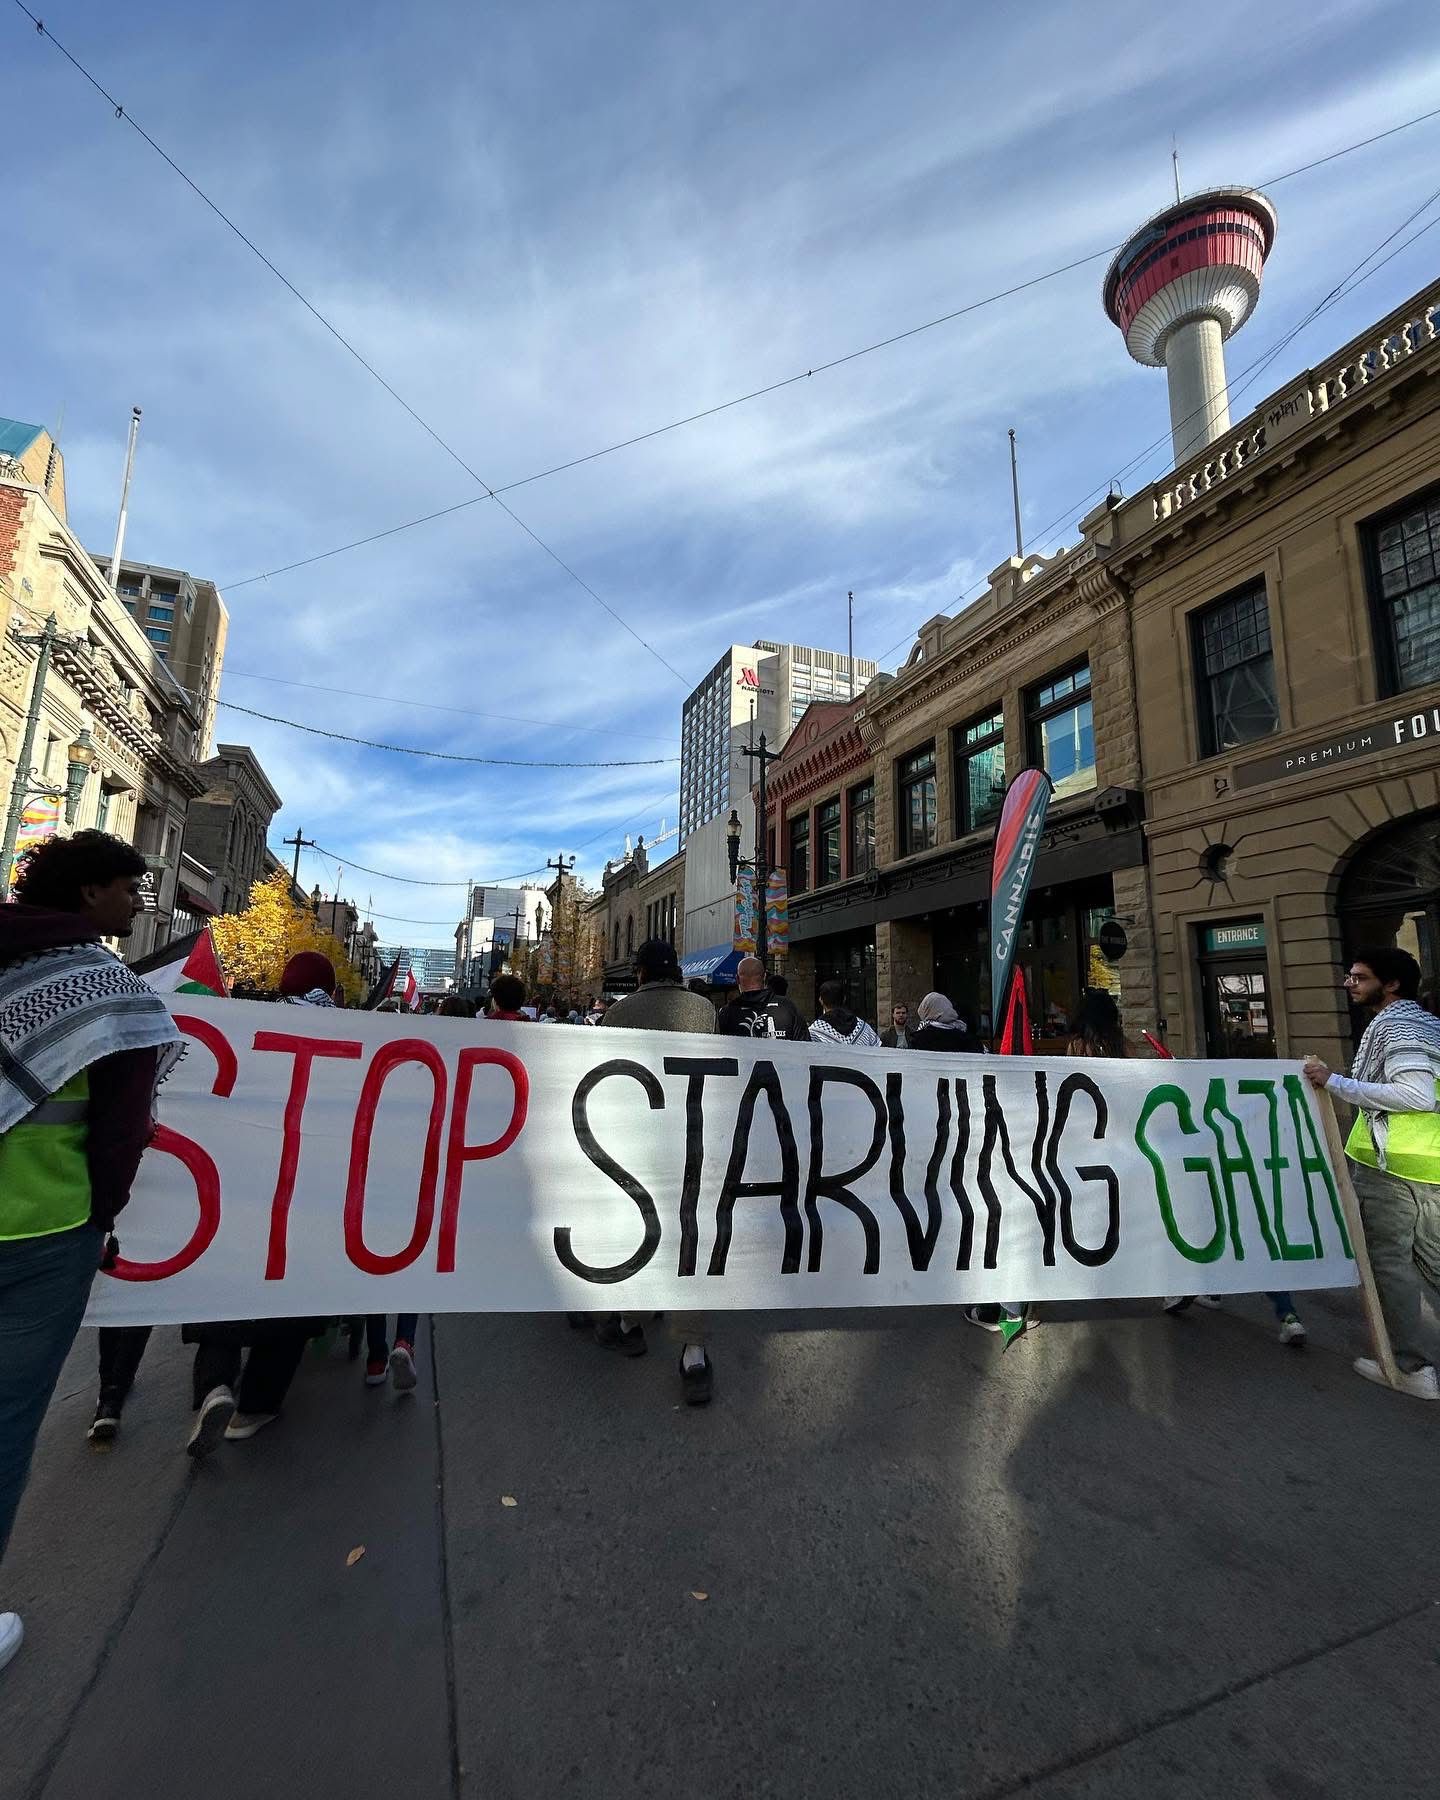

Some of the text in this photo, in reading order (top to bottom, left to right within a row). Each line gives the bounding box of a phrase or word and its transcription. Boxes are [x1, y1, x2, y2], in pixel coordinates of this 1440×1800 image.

[742, 686, 774, 695] MARRIOTT
[1285, 736, 1372, 769] PREMIUM
[995, 813, 1041, 961] CANNABIS
[1216, 927, 1260, 944] ENTRANCE
[101, 1014, 1354, 1284] STOP STARVING GAZA
